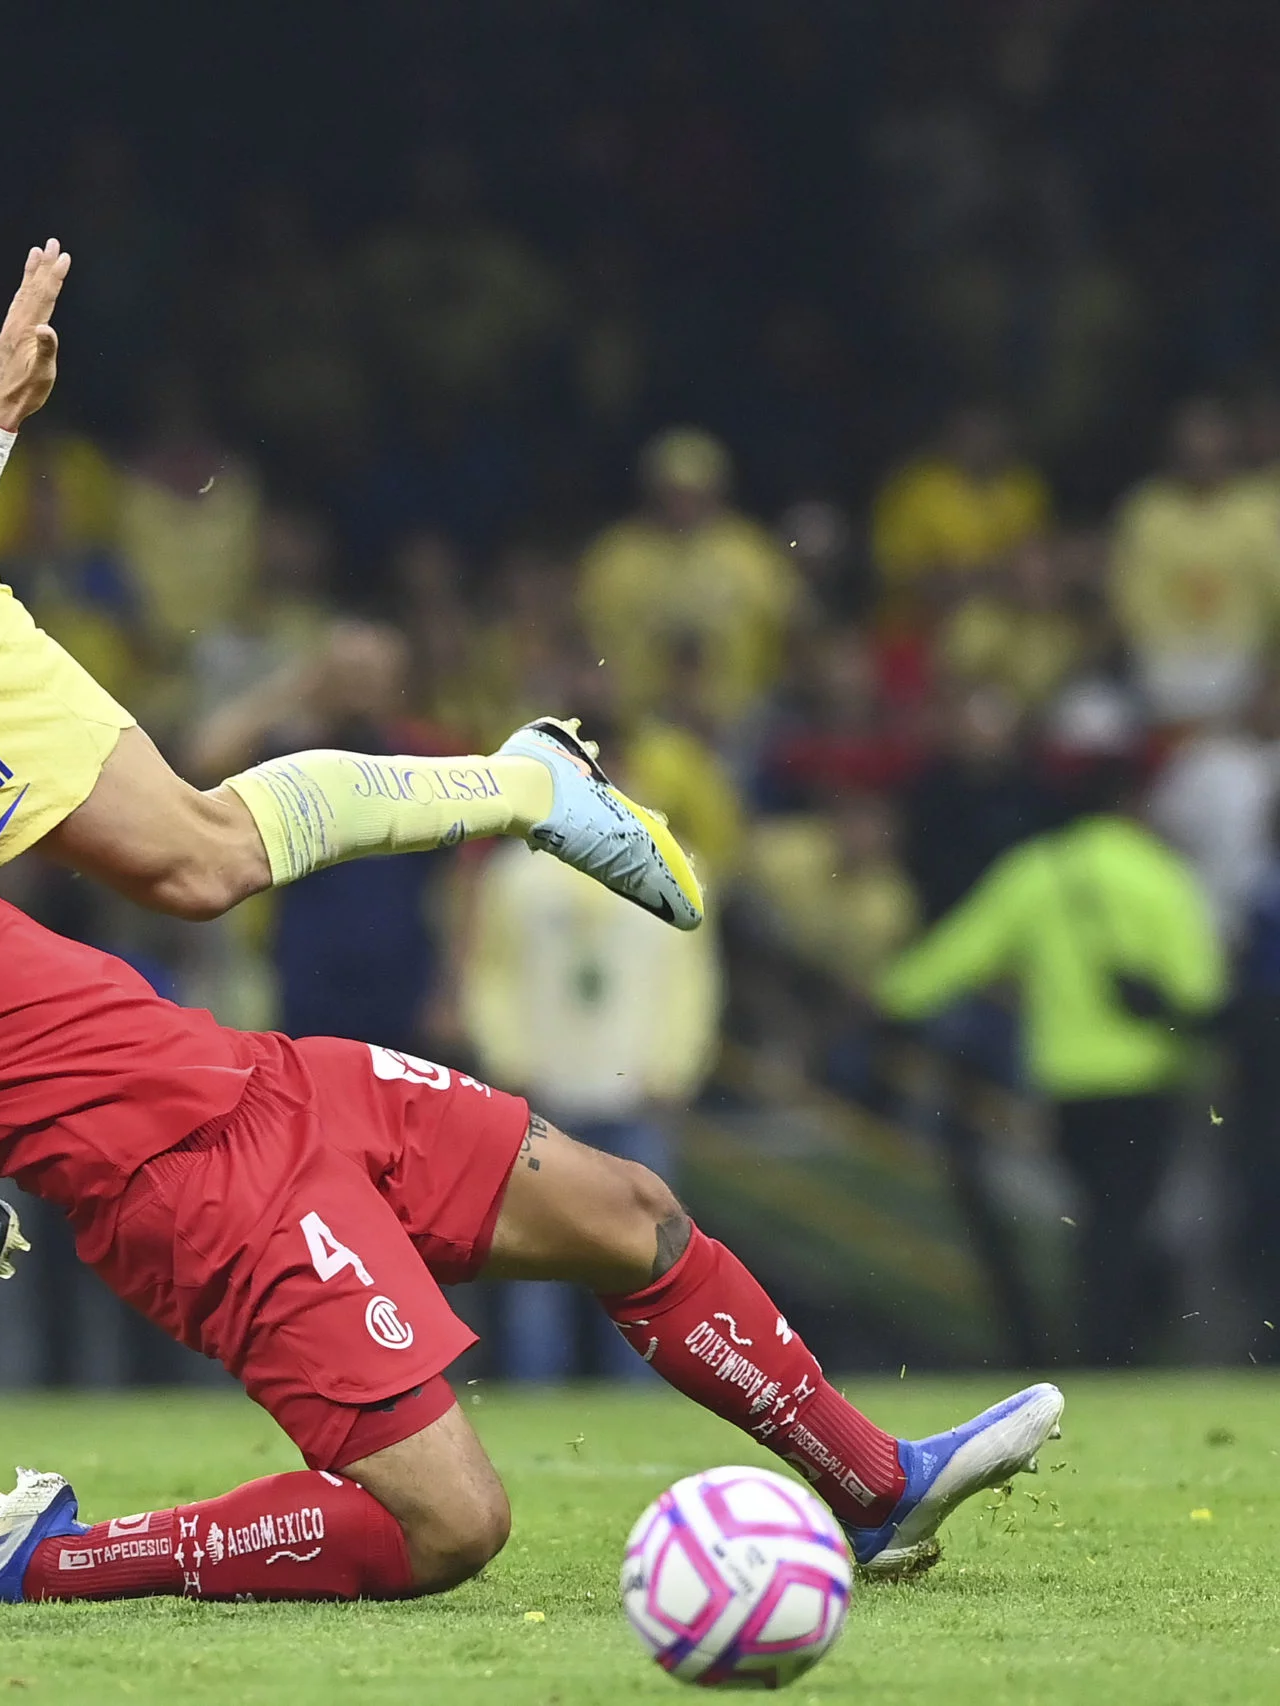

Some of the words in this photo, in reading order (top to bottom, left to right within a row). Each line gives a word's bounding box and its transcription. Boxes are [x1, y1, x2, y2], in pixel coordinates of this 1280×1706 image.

[299, 1210, 376, 1287] 4
[787, 1421, 847, 1480] TAPEDESIG
[93, 1536, 173, 1565] TAPEDESIG
